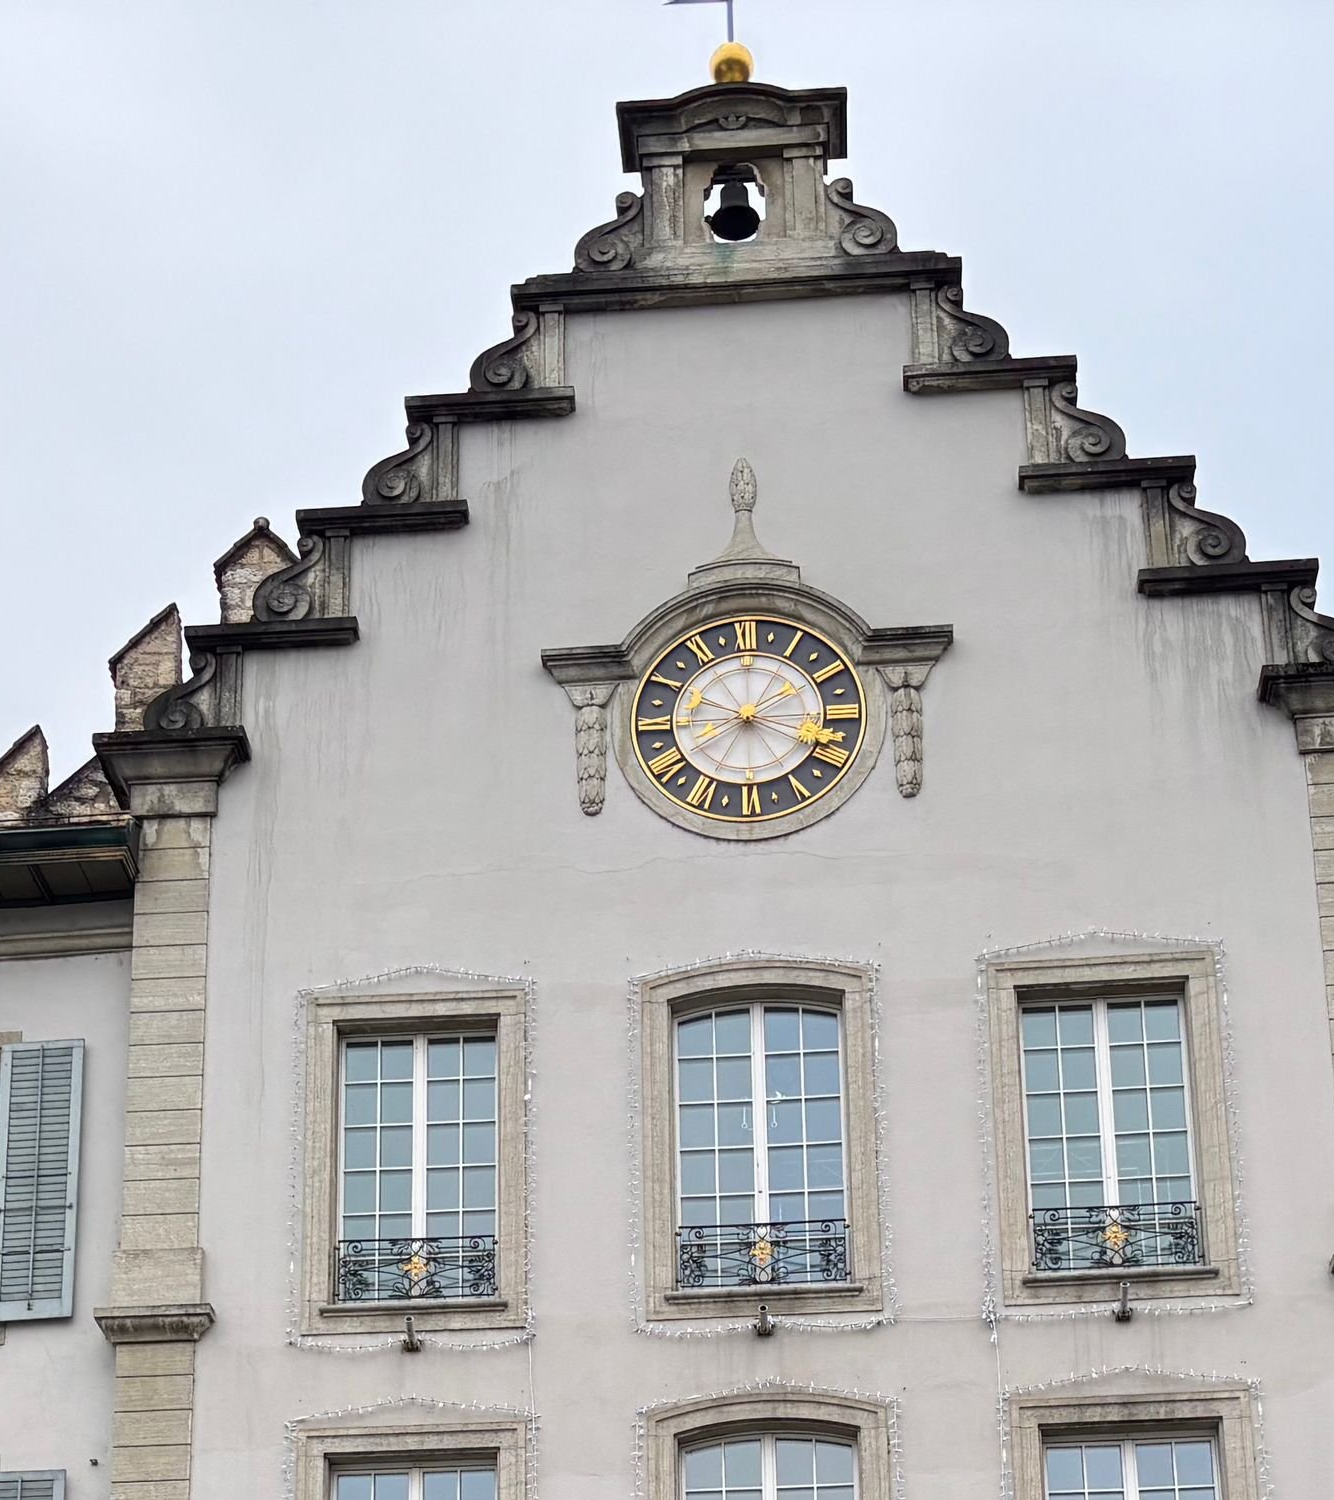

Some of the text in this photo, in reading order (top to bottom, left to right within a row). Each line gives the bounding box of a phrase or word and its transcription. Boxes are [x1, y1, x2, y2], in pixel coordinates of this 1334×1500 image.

[685, 634, 715, 664] XI
[733, 621, 757, 651] XII
[783, 630, 804, 658] I
[651, 671, 683, 691] X
[812, 659, 846, 684] II
[638, 714, 671, 731] IX
[826, 703, 859, 720] III
[648, 746, 687, 784] VIII
[813, 744, 849, 768] IIII
[686, 776, 717, 810] VII
[741, 784, 762, 815] VI
[788, 774, 811, 800] V
